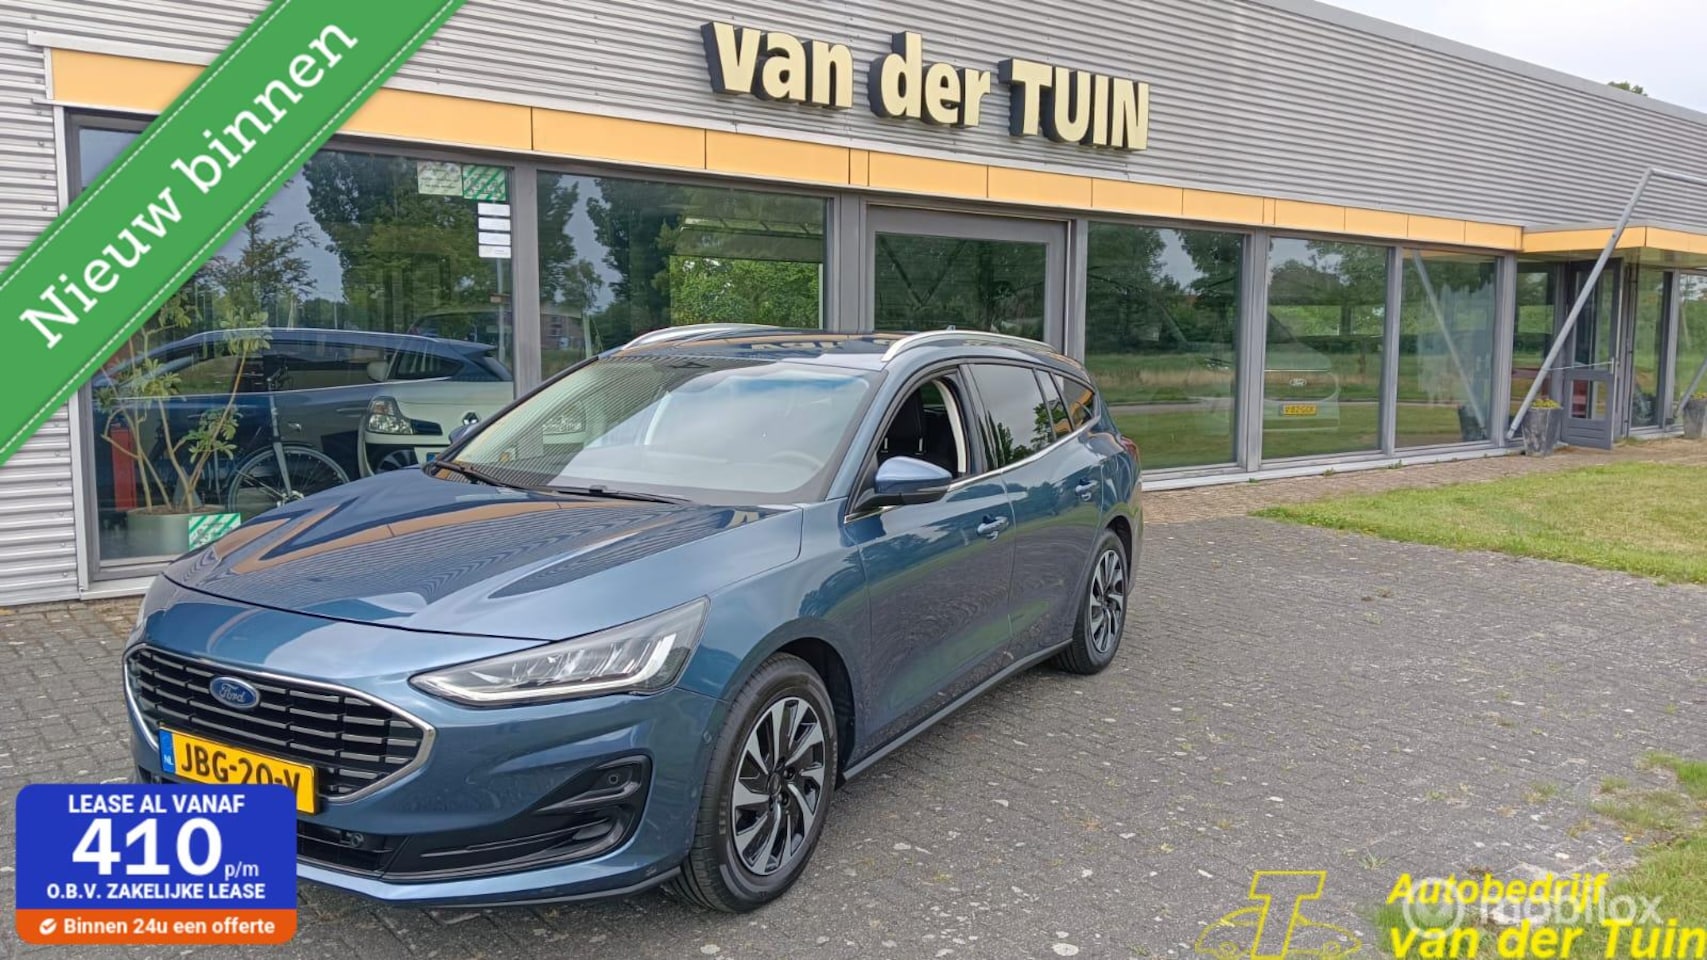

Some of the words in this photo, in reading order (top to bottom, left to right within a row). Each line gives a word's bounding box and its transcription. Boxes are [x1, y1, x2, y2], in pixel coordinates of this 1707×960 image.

[704, 21, 854, 109] van
[872, 31, 992, 128] der
[1001, 58, 1150, 151] TUIN
[163, 754, 175, 766] NL
